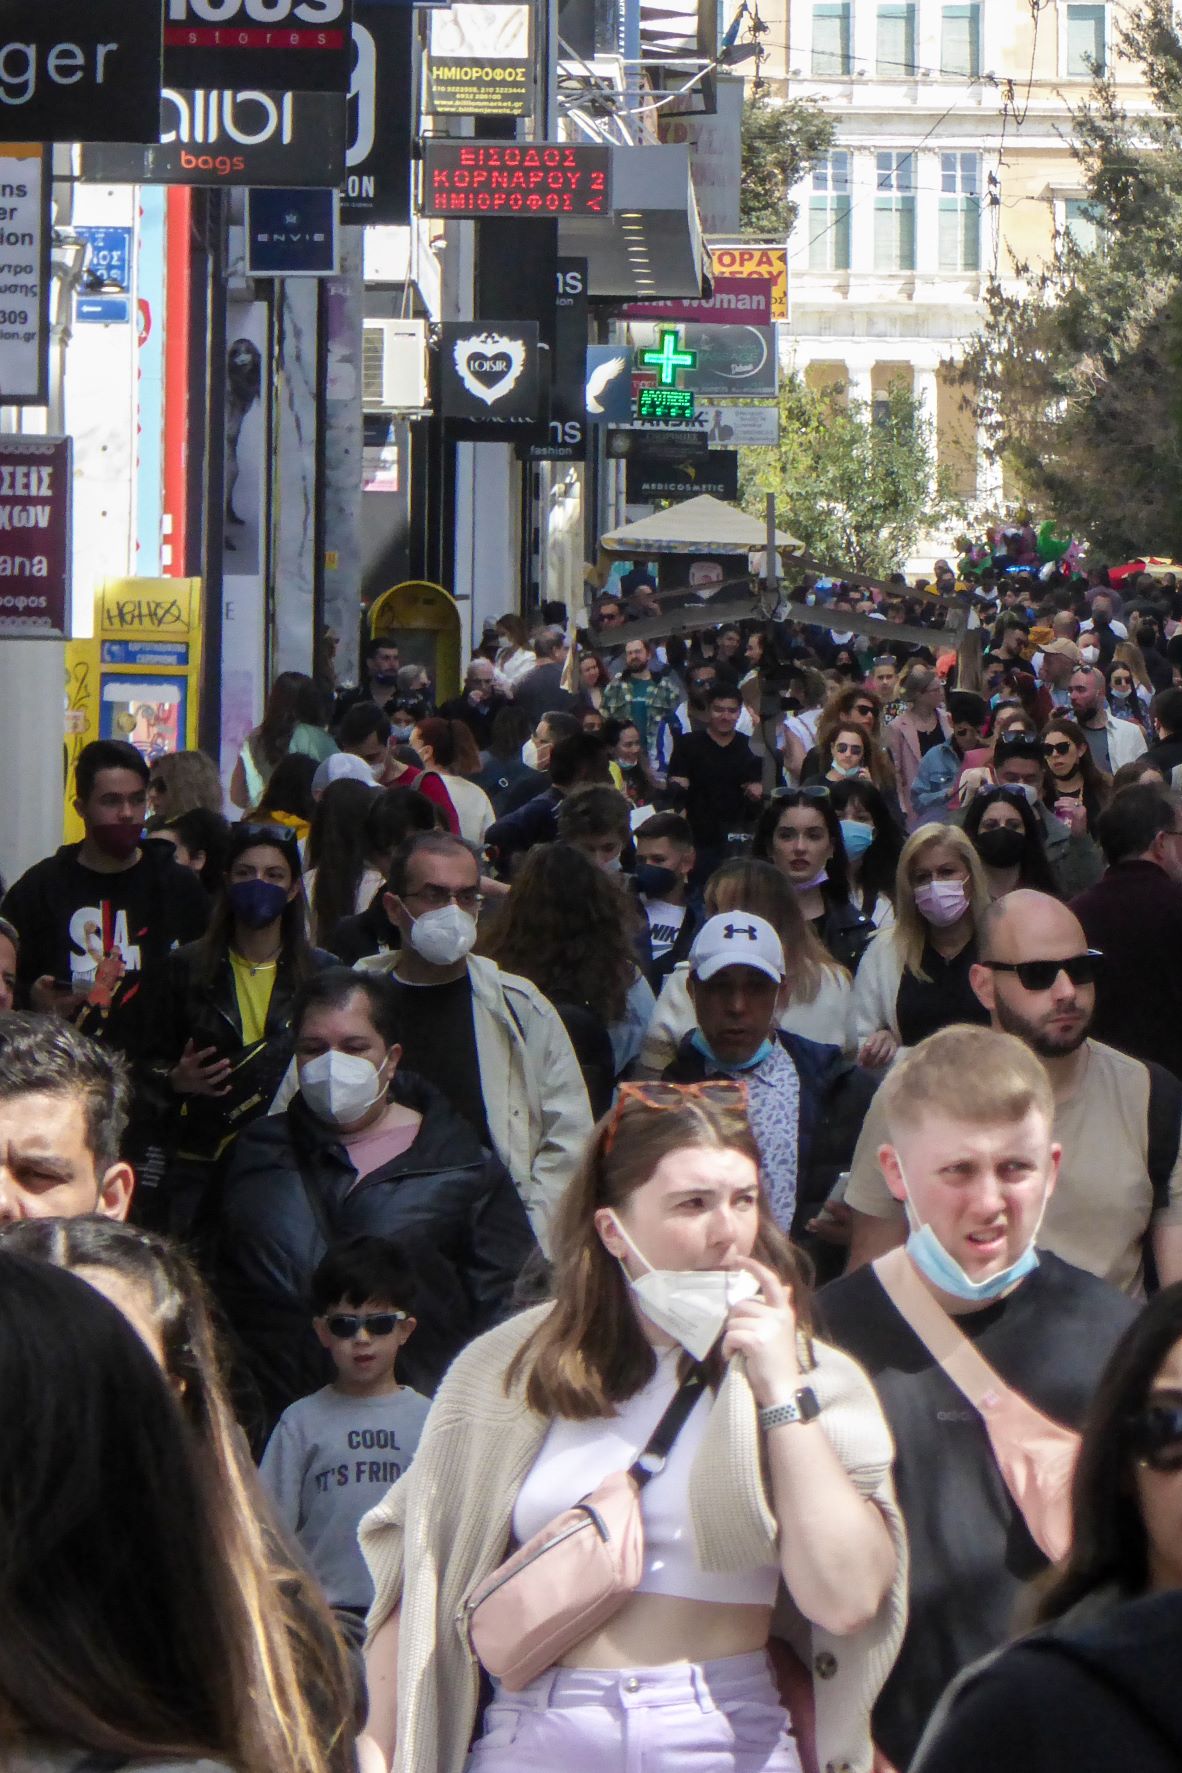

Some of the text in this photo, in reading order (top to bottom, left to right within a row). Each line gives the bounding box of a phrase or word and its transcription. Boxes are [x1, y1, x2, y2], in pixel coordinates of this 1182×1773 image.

[189, 32, 327, 44] stores
[0, 42, 119, 105] ger
[432, 66, 526, 81] ΗΜΙΟΡΟΦΟΣ
[181, 150, 245, 174] bags
[460, 147, 576, 166] ΕΙΣΟΔΟΣ
[433, 169, 605, 190] ΚΟΡΝΑΡΟΥ 2
[434, 192, 574, 210] ΗΜΙΟΡΟΦΟΣ
[712, 251, 774, 268] ΟΡΑ
[530, 445, 573, 456] fashion
[641, 482, 725, 492] MEDICOSMETIC
[650, 923, 682, 944] NIK
[348, 1429, 400, 1451] COOL
[315, 1461, 405, 1494] IT'S FRID
